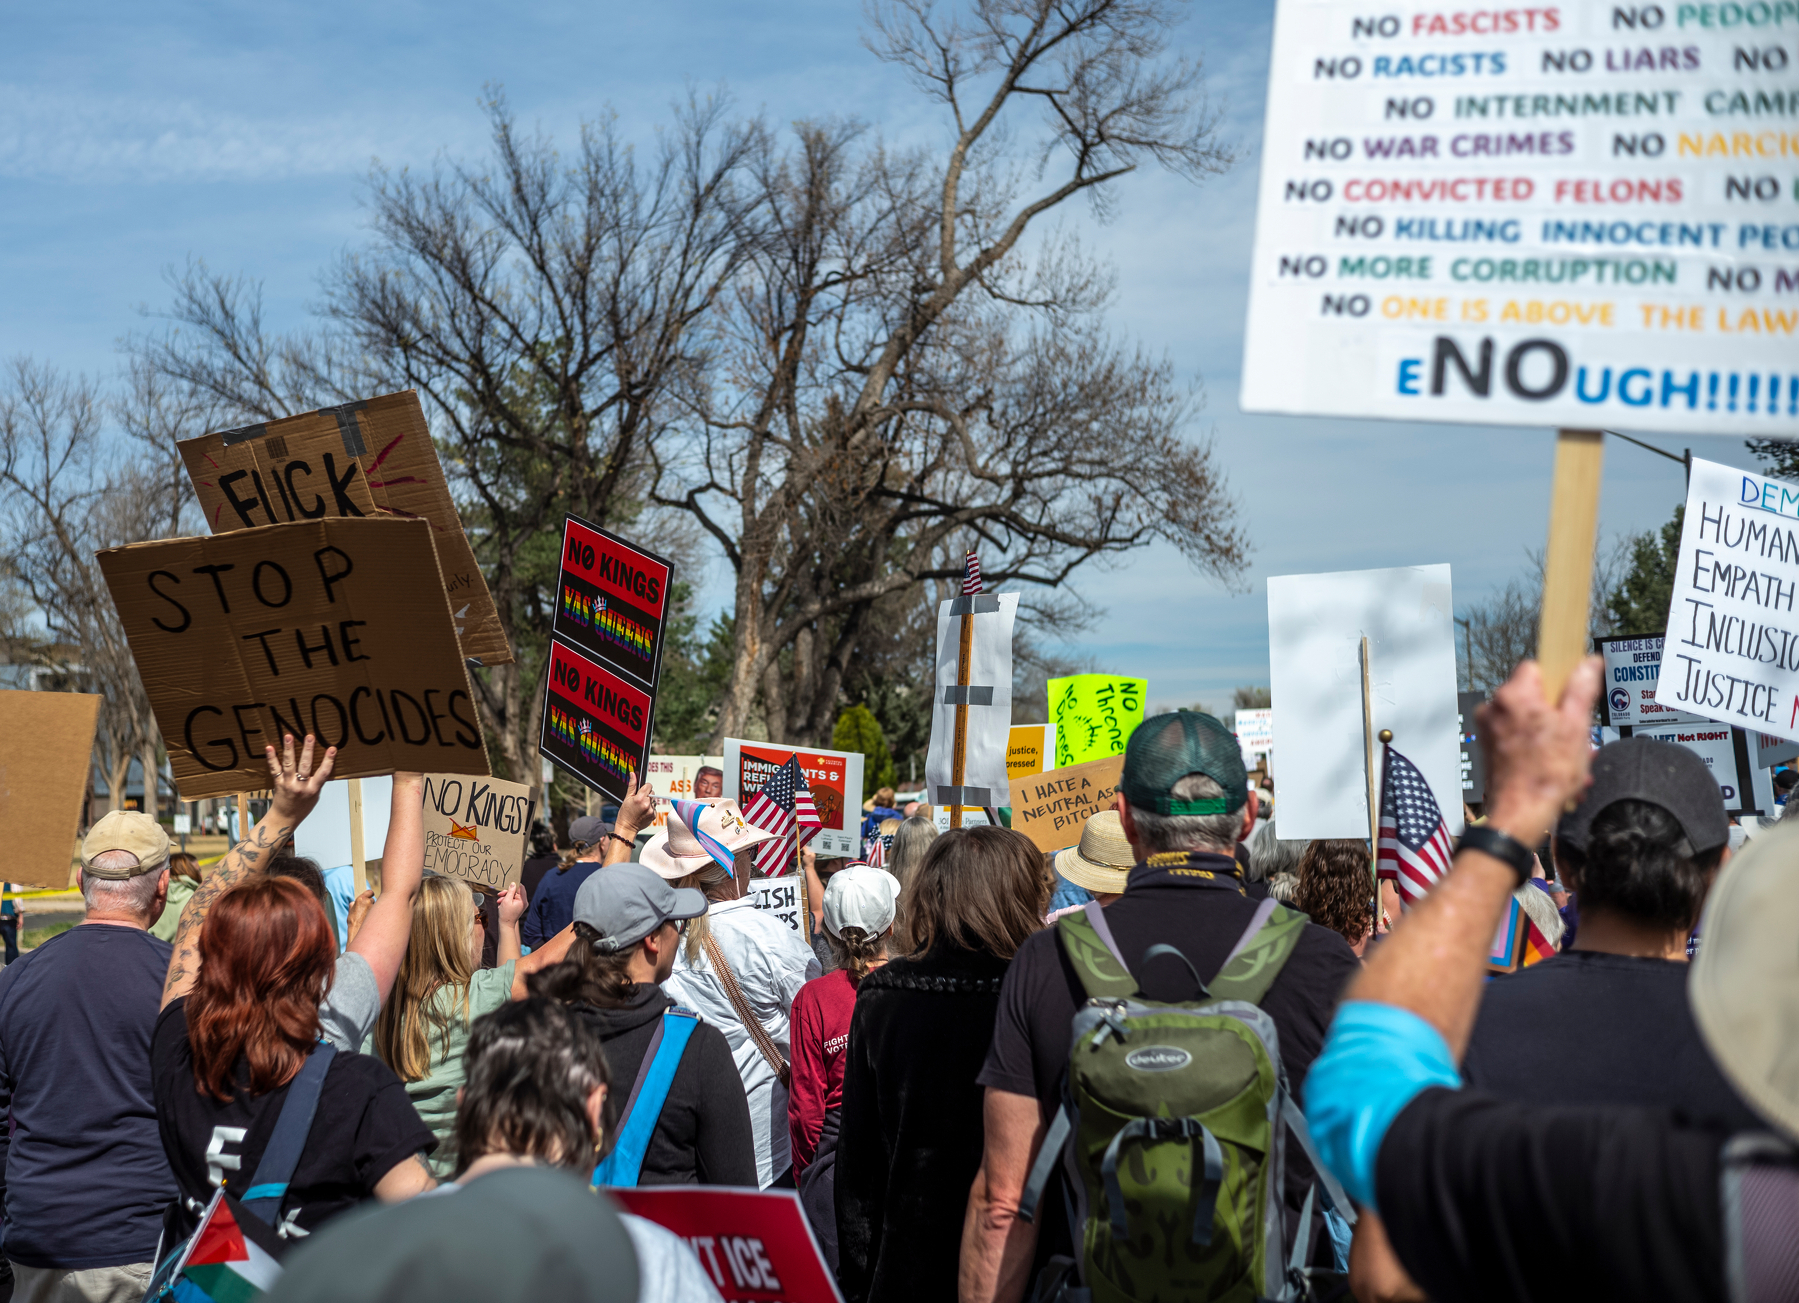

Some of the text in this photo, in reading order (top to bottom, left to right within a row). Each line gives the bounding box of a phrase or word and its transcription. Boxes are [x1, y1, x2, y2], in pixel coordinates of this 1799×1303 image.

[1353, 0, 1799, 39] NO FASCISTS NO PEDOP
[1314, 45, 1789, 79] NO RACISTS NO LIARS NO
[1386, 96, 1434, 120] NO
[1455, 90, 1682, 119] INTERNMENT
[1304, 138, 1353, 162] NO
[1363, 135, 1440, 160] WAR
[1450, 131, 1575, 158] CRIMES
[1612, 132, 1666, 157] NO
[1284, 179, 1333, 202] NO
[1343, 177, 1535, 202] CONVICTED
[1555, 177, 1683, 204] FELONS
[1726, 175, 1781, 201] NO
[1335, 216, 1384, 239] NO
[1394, 217, 1521, 244] KILLING
[1542, 220, 1726, 247] INNOCENT
[1278, 256, 1327, 279] NO
[1338, 255, 1433, 280] MORE
[1451, 257, 1677, 284] CORRUPTION
[1707, 265, 1762, 291] NO
[1322, 294, 1799, 335] NO ONE IS ABOVE THE LAW
[148, 546, 353, 634] STOP
[599, 552, 660, 605] KINGS
[1693, 548, 1795, 612] EMPATH
[563, 584, 654, 663] YAS QUEENS
[241, 620, 371, 676] THE
[1610, 640, 1643, 653] SILENCE
[1645, 639, 1653, 650] IS
[1633, 651, 1661, 663] DEFEND
[584, 676, 643, 732] KINGS
[1119, 683, 1138, 712] NO
[1676, 654, 1779, 723] JUSTICE
[1096, 683, 1124, 755] Throne
[1640, 703, 1664, 715] Speak
[184, 686, 483, 772] GENOCIDES
[550, 704, 636, 786] YAS QUEENS
[1677, 733, 1696, 742] Not
[1697, 731, 1729, 741] RIGHT
[660, 762, 673, 773] THIS
[1008, 745, 1038, 757] justice,
[829, 771, 839, 781] &
[1021, 777, 1091, 803] I HATE A
[423, 777, 536, 836] NO KINGS!
[1022, 787, 1113, 822] NEUTRAL AS
[1053, 804, 1100, 831] BITCH
[426, 830, 492, 855] PROTECT OUR
[423, 844, 513, 888] EMOCRACY
[824, 1033, 849, 1049] FIGHT
[720, 1236, 781, 1290] ICE
